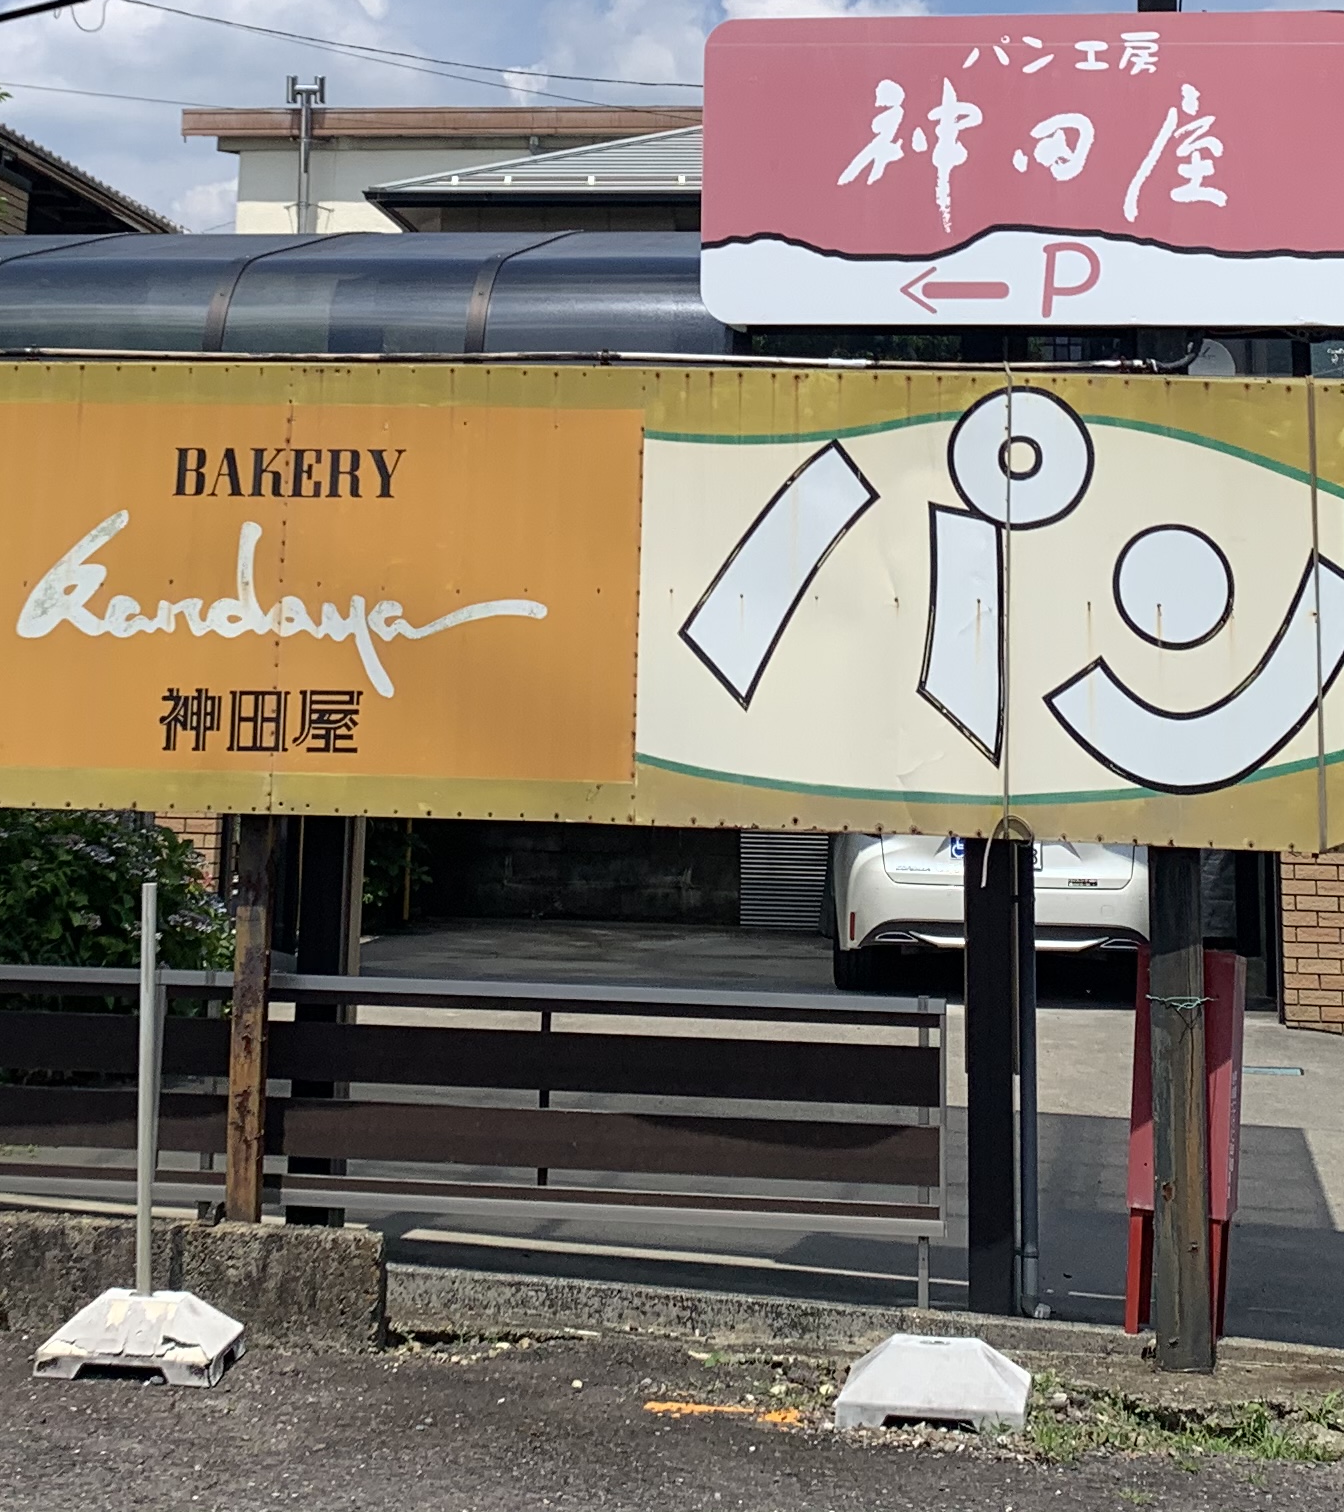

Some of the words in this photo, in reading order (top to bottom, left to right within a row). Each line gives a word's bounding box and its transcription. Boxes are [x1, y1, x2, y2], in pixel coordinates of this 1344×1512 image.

[962, 30, 1160, 76] パン工房
[836, 76, 1228, 233] 神田屋
[1041, 242, 1101, 318] P
[172, 446, 407, 499] BAKERY
[158, 688, 364, 754] 神田屋
